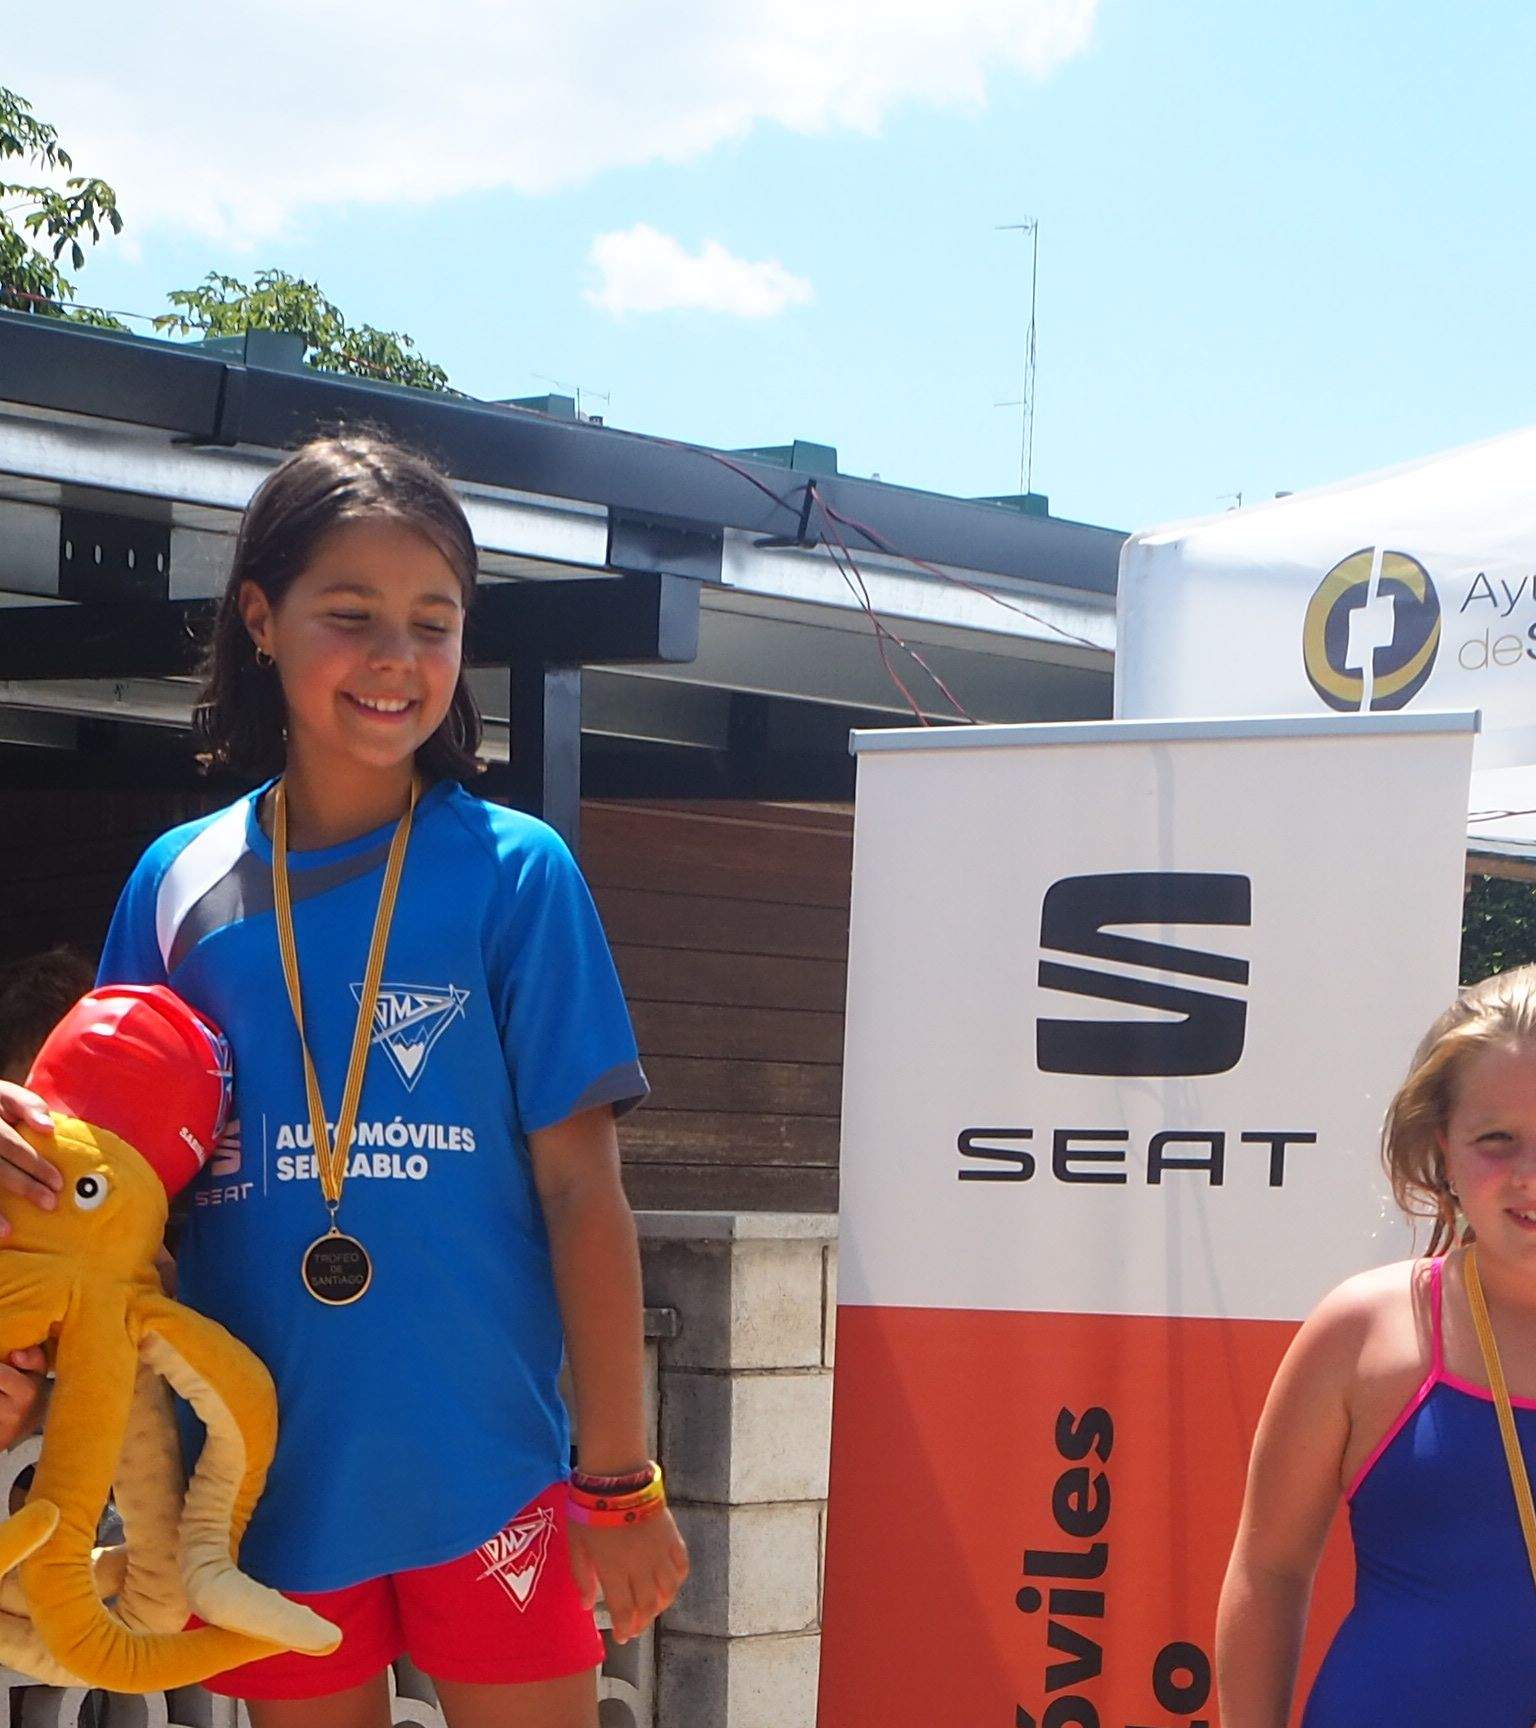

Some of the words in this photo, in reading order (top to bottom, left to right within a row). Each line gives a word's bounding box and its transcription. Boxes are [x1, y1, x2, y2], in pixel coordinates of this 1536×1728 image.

[276, 1153, 429, 1181] SEABLO
[956, 1127, 1317, 1187] SEAT
[195, 1182, 255, 1207] SEAT
